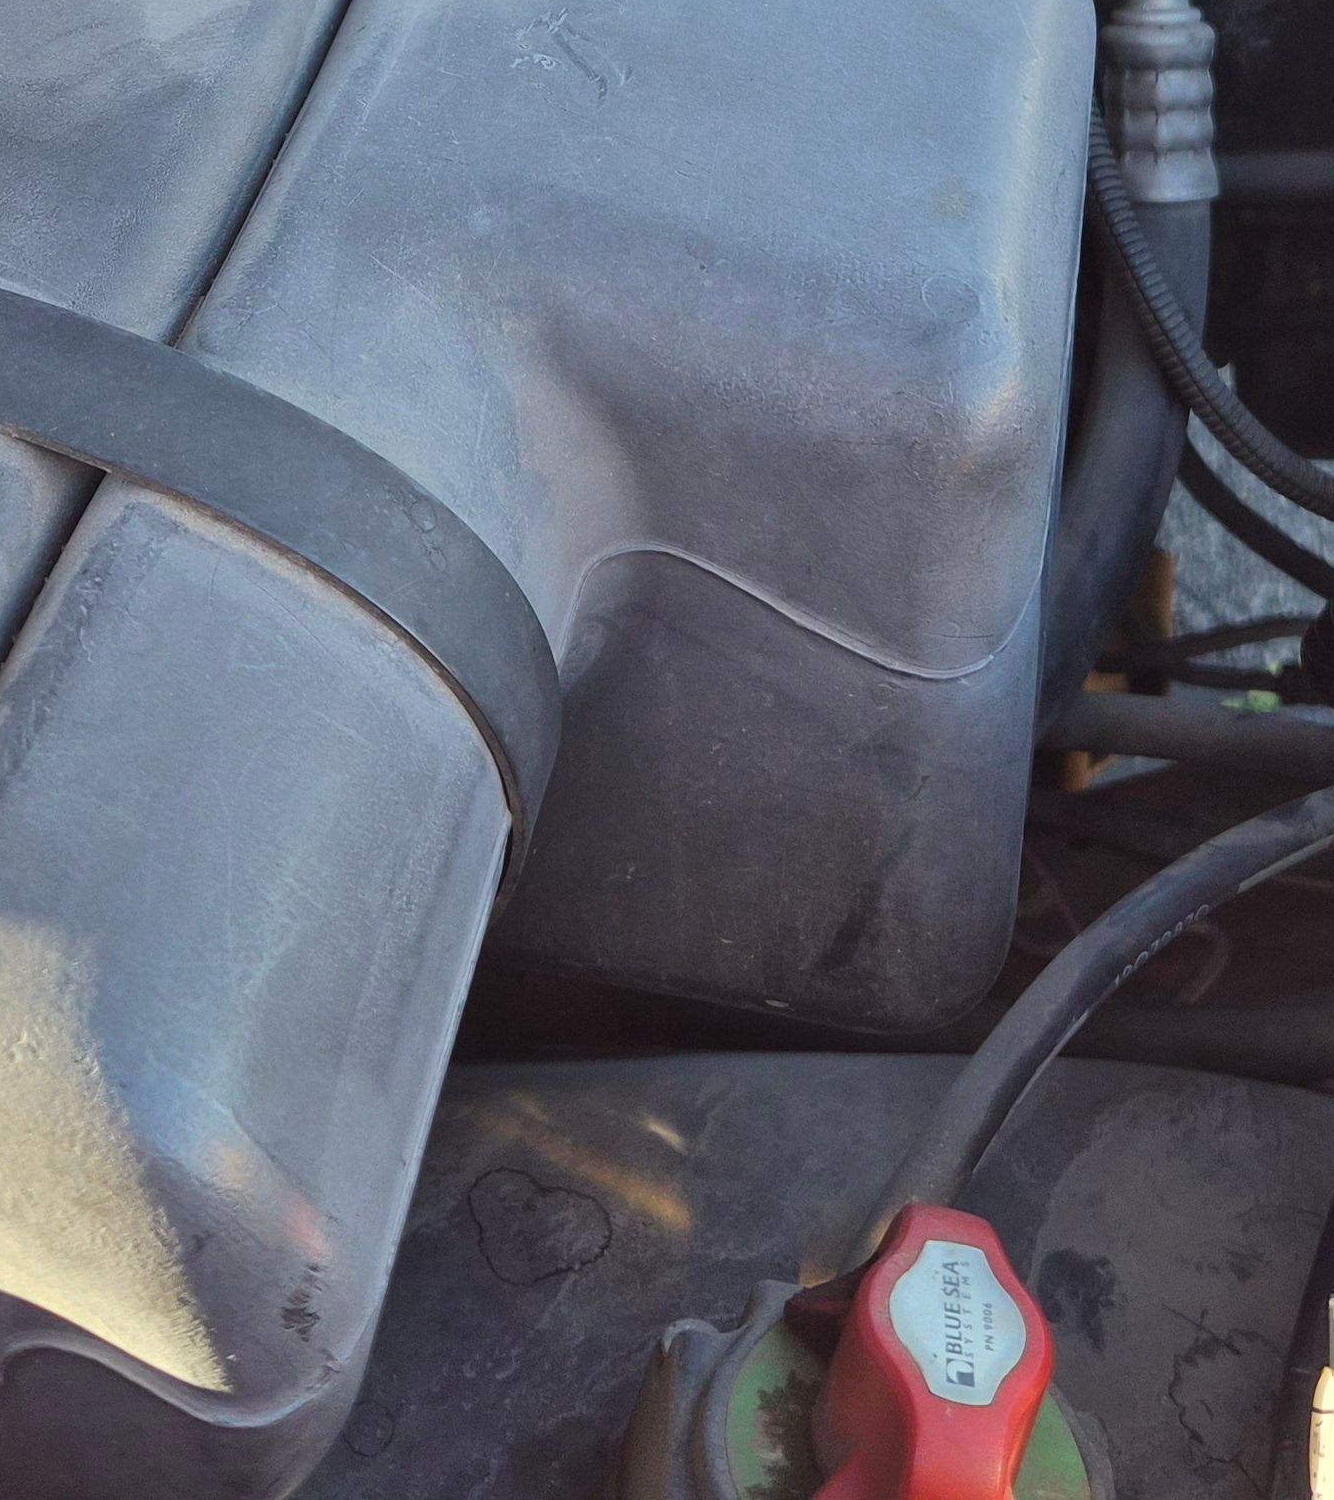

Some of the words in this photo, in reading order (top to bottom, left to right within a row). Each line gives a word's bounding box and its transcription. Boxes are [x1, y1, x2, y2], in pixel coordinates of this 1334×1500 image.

[941, 1260, 962, 1299] SEA
[945, 1301, 964, 1357] BLUE
[963, 1260, 974, 1359] SYSTEMS
[983, 1302, 992, 1330] 9006
[983, 1334, 994, 1351] PN
